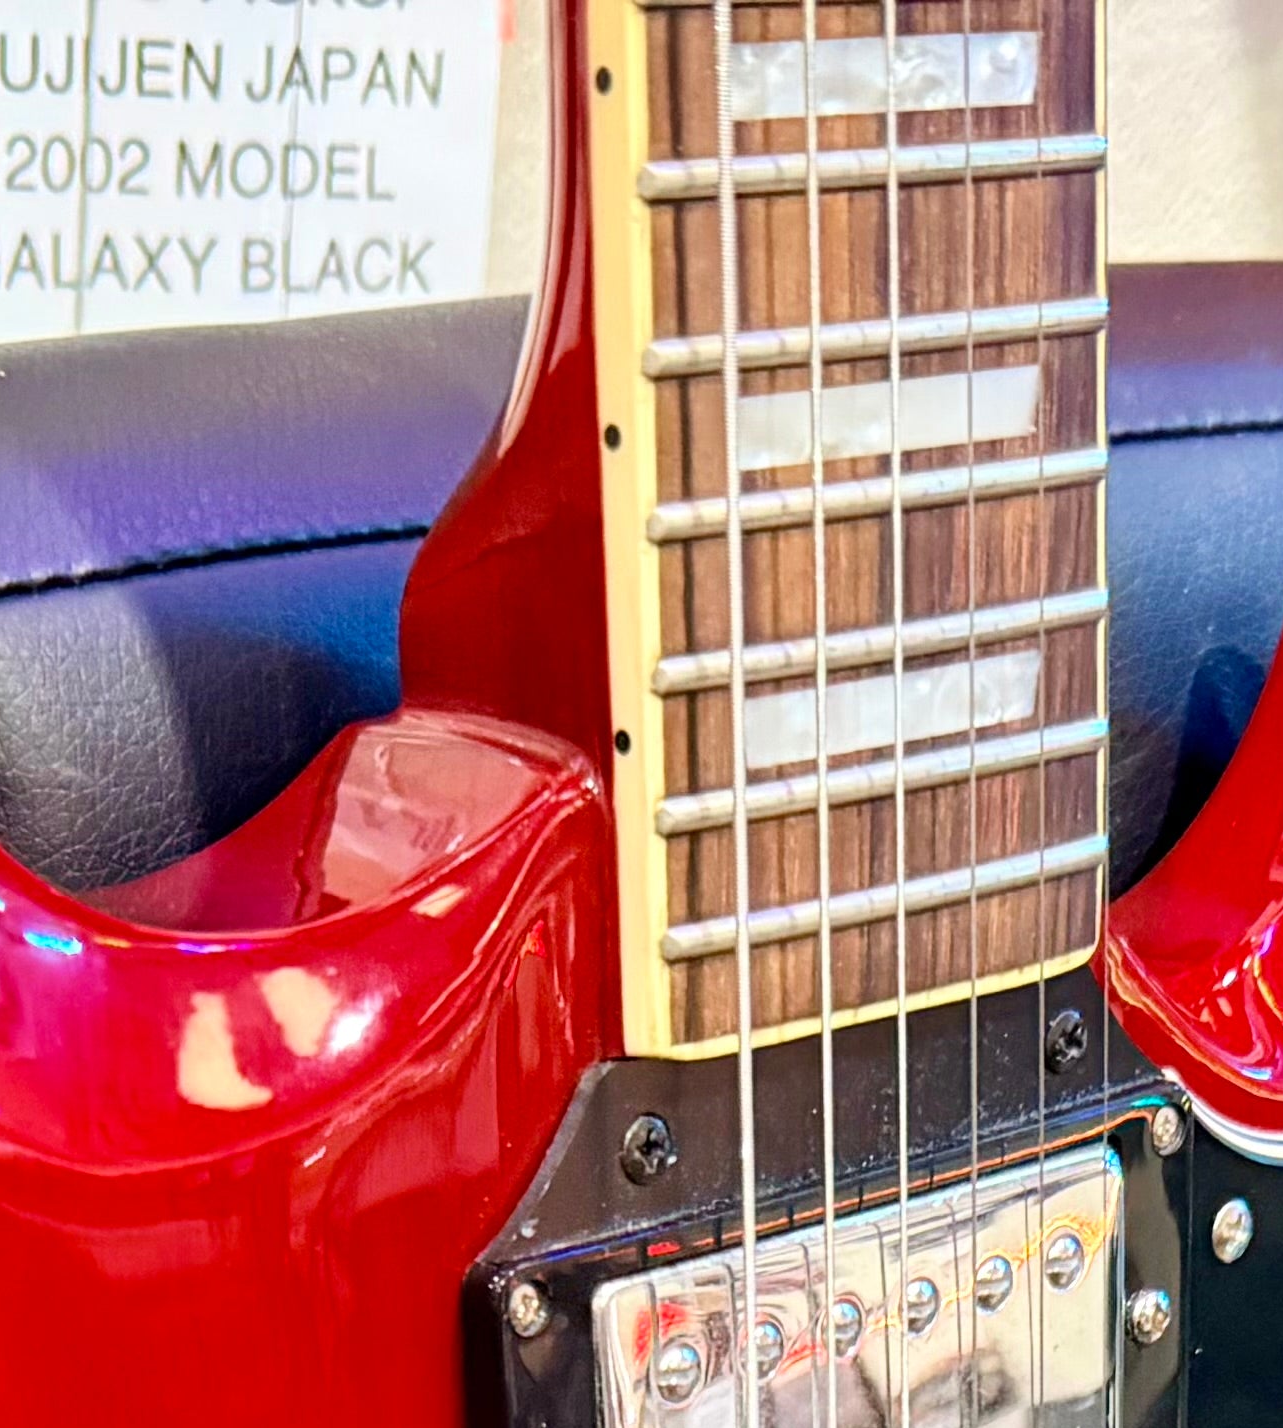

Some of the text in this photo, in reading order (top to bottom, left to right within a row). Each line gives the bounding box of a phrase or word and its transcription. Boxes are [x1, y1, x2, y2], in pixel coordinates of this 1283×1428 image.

[245, 44, 445, 107] JAPAN
[5, 134, 397, 202] 2002 MODEL
[241, 237, 437, 295] BLACK
